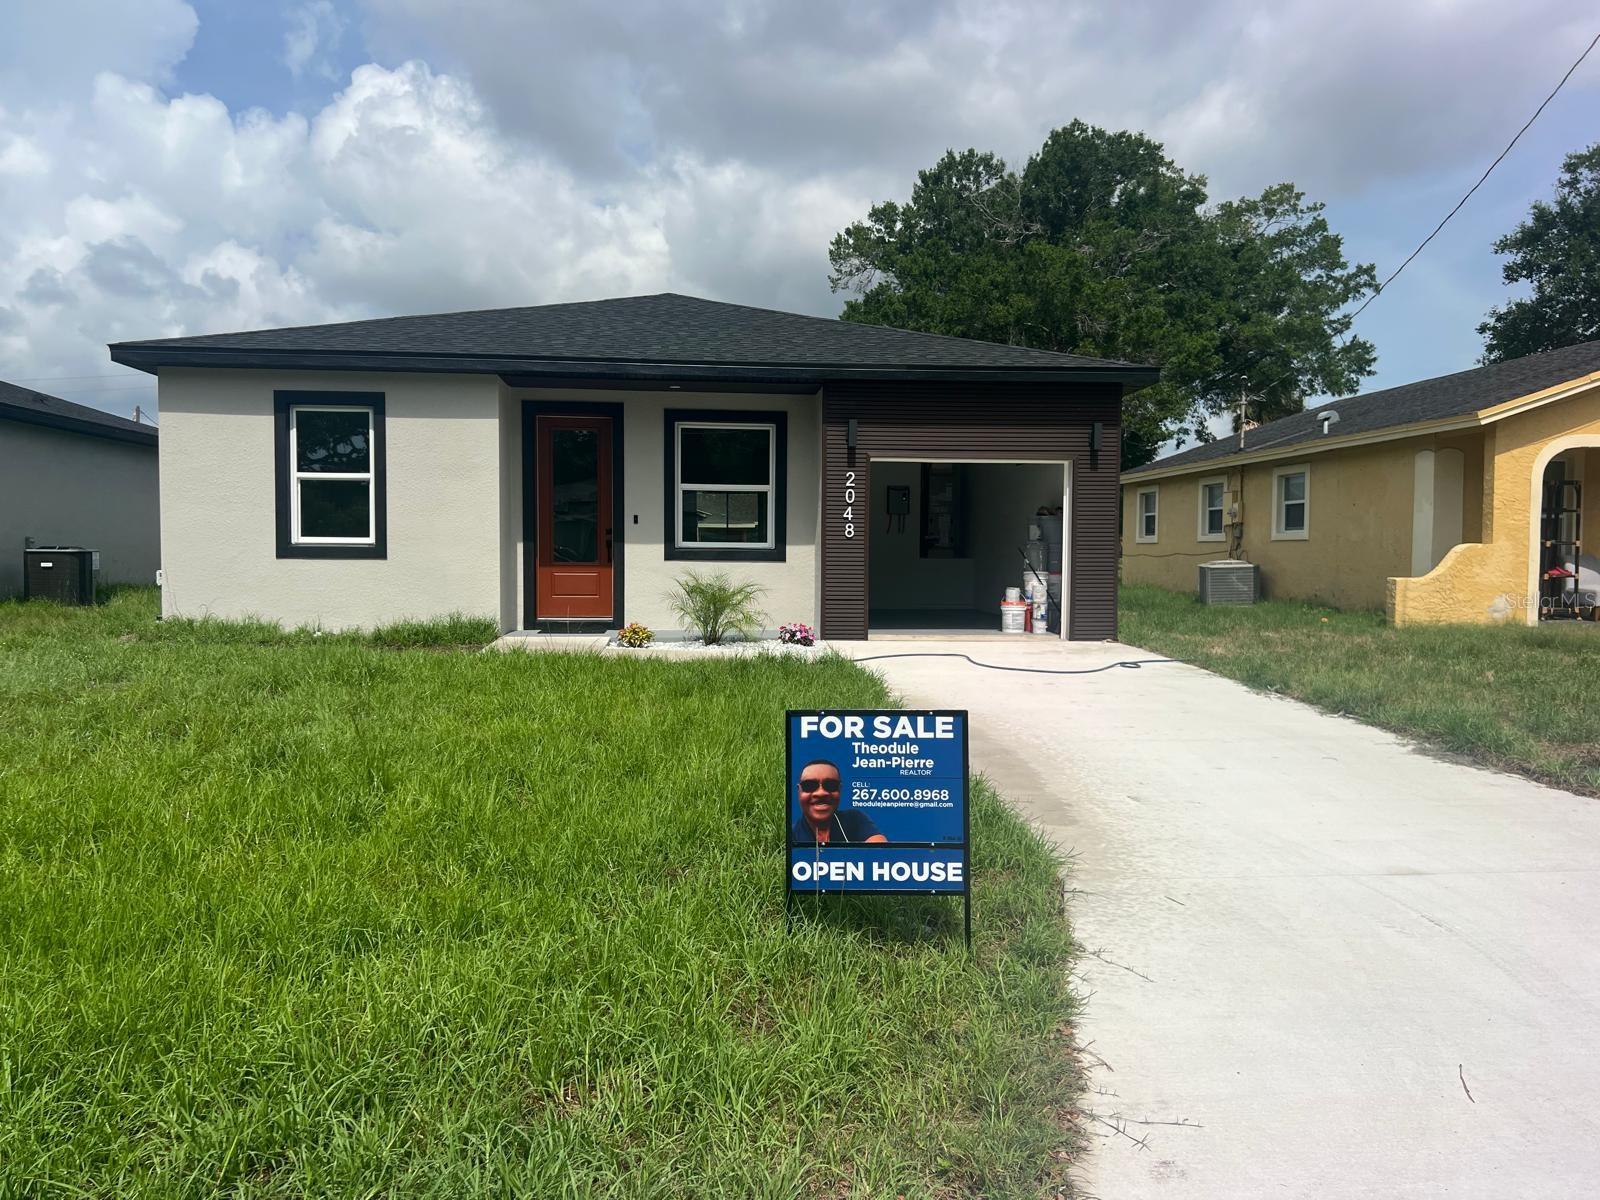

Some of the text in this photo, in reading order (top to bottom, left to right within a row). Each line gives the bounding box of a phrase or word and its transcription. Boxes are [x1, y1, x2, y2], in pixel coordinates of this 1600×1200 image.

[843, 471, 856, 538] 2048
[801, 716, 954, 739] FOR SALE
[852, 742, 919, 755] Theodule
[852, 757, 934, 769] Jean-Pierre
[852, 789, 949, 801] 267.600.8968
[852, 801, 954, 809] theodulejeanpierre@gmail.com
[792, 861, 963, 882] OPEN HOUSE
